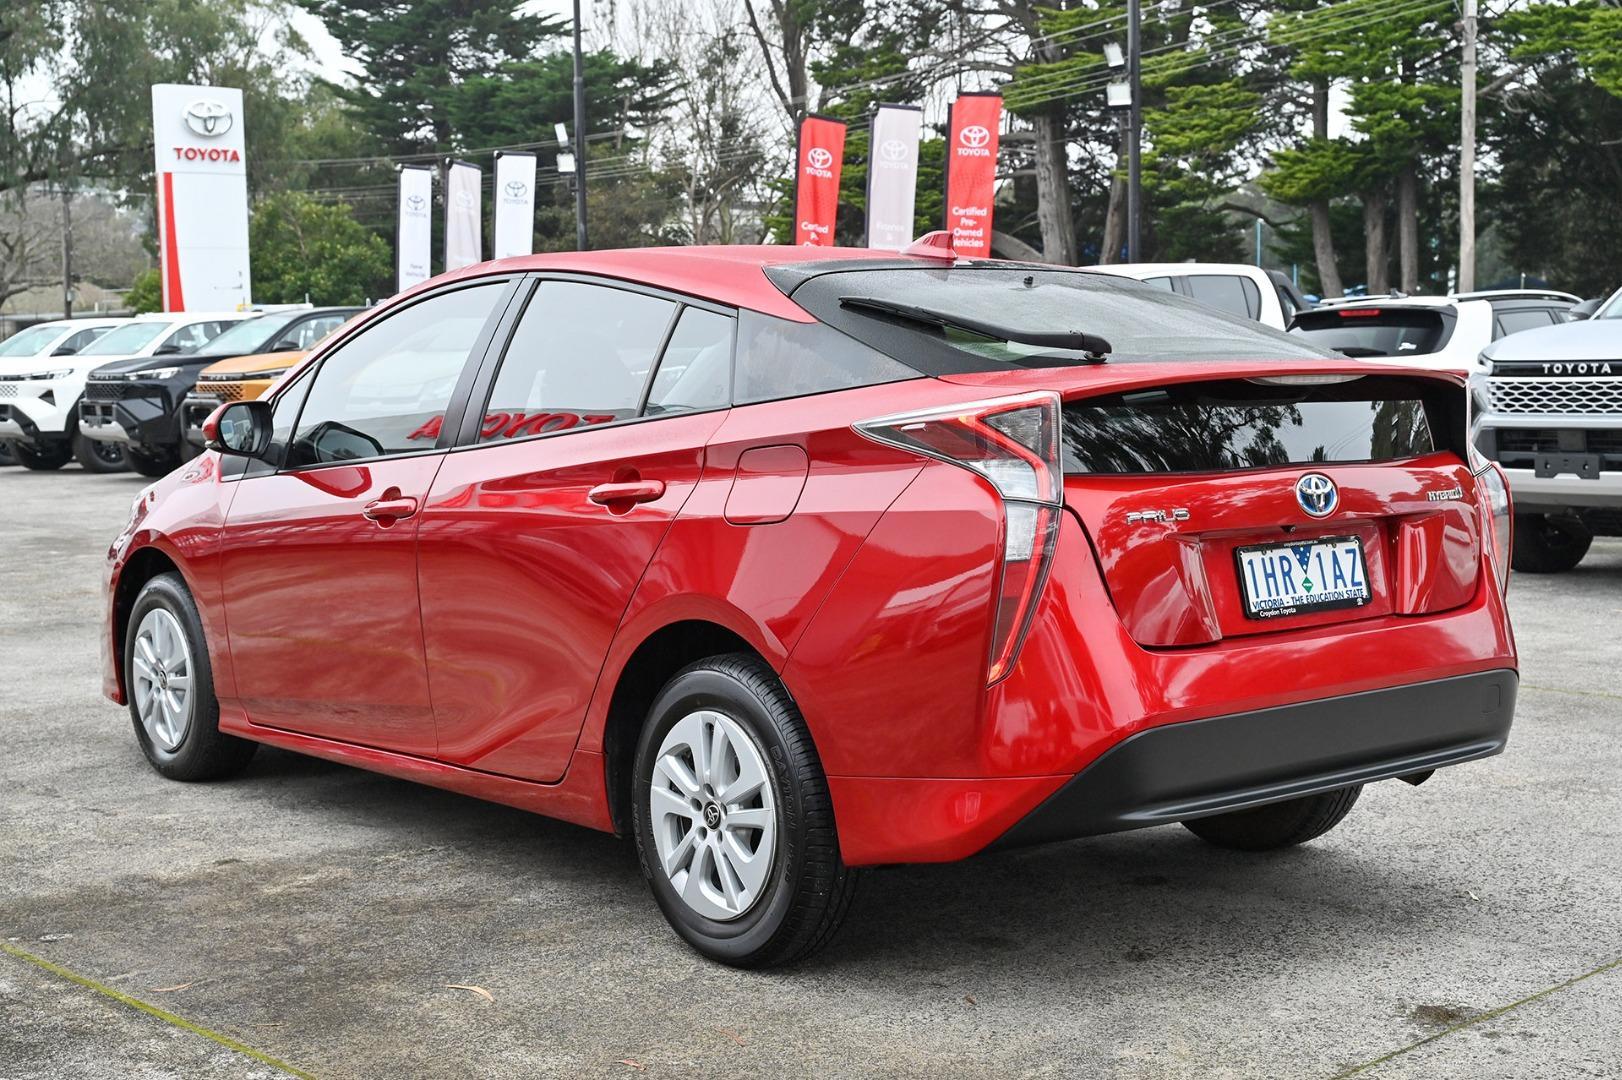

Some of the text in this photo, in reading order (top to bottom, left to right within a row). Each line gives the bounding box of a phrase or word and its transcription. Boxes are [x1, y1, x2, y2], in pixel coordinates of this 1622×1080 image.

[173, 147, 240, 162] TOYOTA
[957, 147, 990, 157] TOYOTA
[805, 166, 832, 179] TOOTA
[952, 206, 987, 216] Certified
[960, 216, 977, 226] Pre-
[953, 227, 983, 237] Owned
[1542, 362, 1612, 374] TOYOTA
[1126, 508, 1190, 525] PRIUS
[1252, 597, 1285, 610] VICTORIA
[1291, 595, 1304, 606] THE
[1305, 590, 1345, 605] EDUCATION
[1345, 588, 1364, 599] STATE
[1259, 607, 1297, 618] Croydon Toyota
